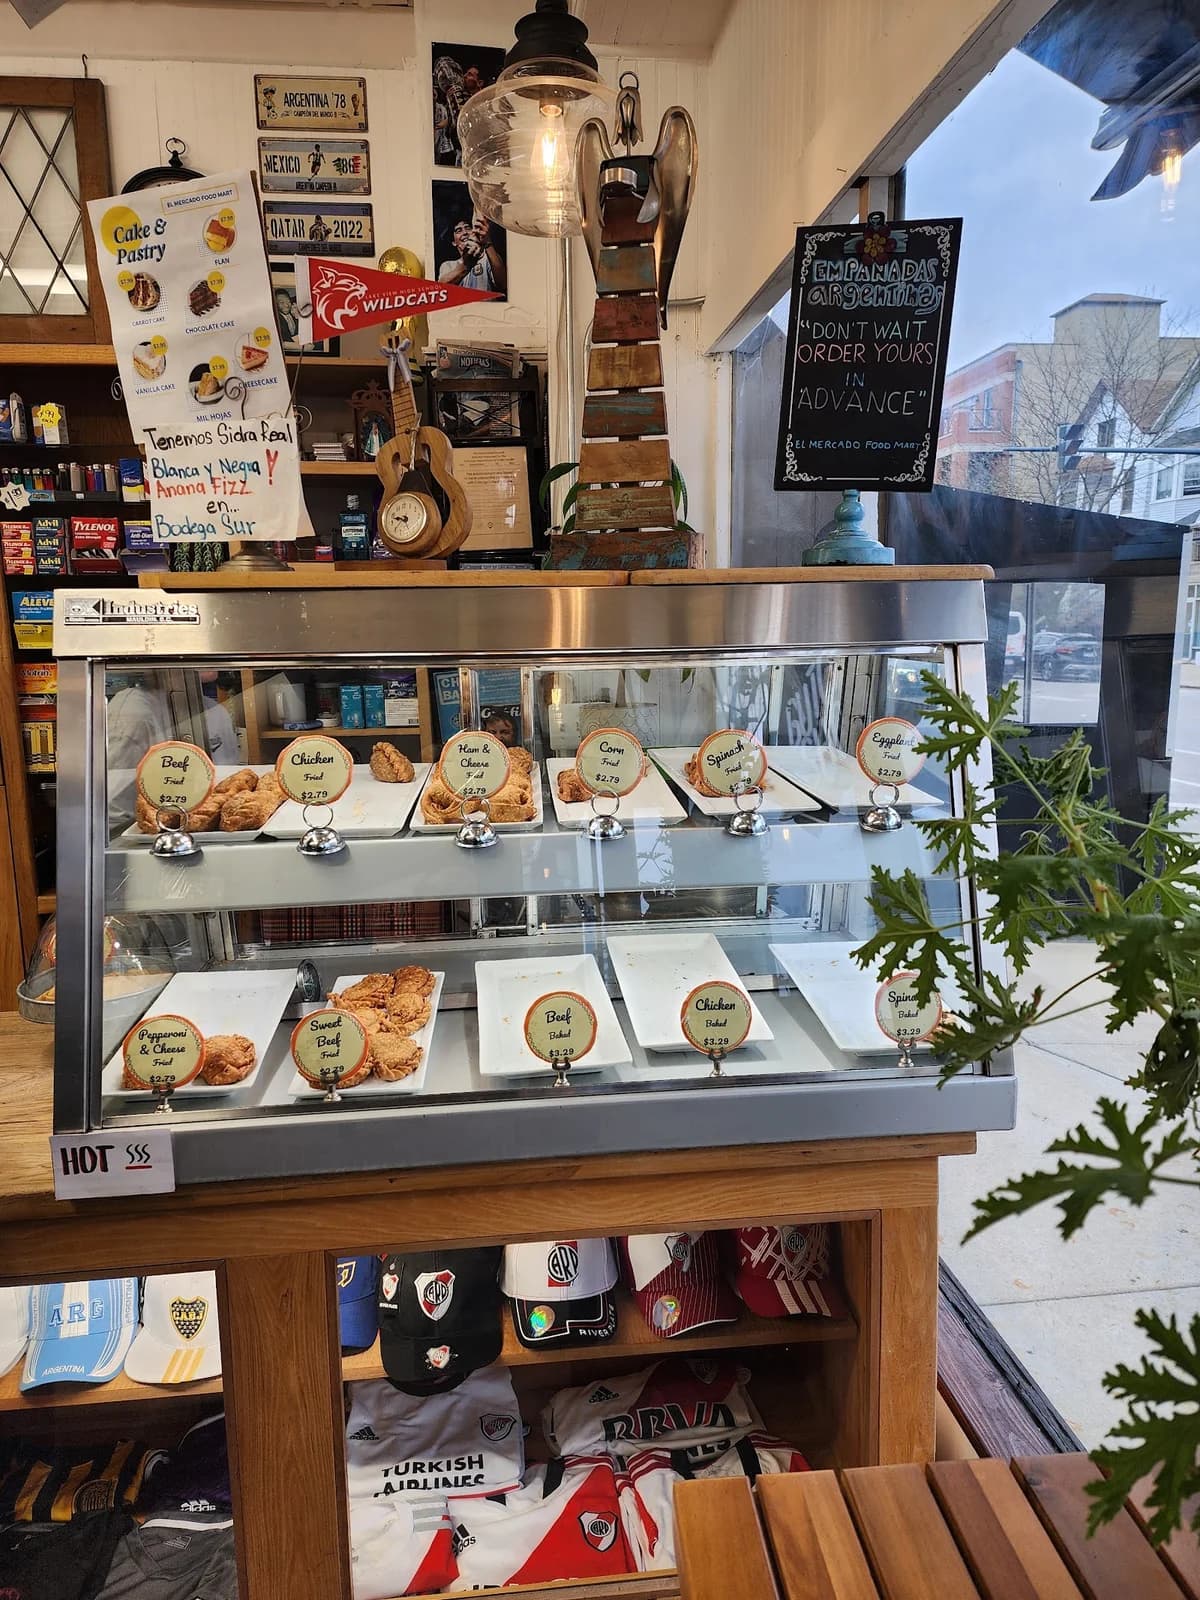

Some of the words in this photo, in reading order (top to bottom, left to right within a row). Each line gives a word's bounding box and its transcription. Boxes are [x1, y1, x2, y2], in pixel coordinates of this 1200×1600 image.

[283, 92, 329, 108] ARGENTINA
[331, 92, 347, 109] '78
[264, 155, 300, 174] MEXICO
[166, 201, 173, 209] EL
[174, 194, 200, 207] MERCADO
[201, 192, 217, 203] FOOD
[217, 189, 233, 200] MART
[113, 222, 151, 244] Cake
[154, 217, 167, 235] &
[270, 218, 305, 239] QATAR
[333, 219, 363, 238] 2022
[115, 242, 166, 266] Pastry
[214, 257, 230, 267] FLAN
[811, 257, 940, 283] EMPANADAS
[362, 289, 448, 313] WILDCATS
[131, 317, 152, 327] CARROT
[152, 315, 166, 324] CAKE
[185, 322, 218, 335] CHOCOLATE
[217, 319, 235, 329] CAKE
[873, 319, 927, 342] WAIT
[797, 343, 866, 364] ORDER
[873, 342, 934, 365] YOURS
[845, 372, 865, 388] IN
[135, 384, 160, 396] VANILLA
[160, 382, 176, 392] CAKE
[196, 413, 210, 423] MIL
[210, 410, 232, 421] HOJAS
[142, 426, 214, 452] Tenemos
[217, 422, 259, 446] Sidra
[261, 419, 294, 444] Real
[795, 439, 806, 449] EL
[808, 440, 861, 450] MERCADO
[865, 440, 891, 450] FOOD
[151, 456, 201, 480] Blanca
[219, 457, 262, 481] Negra
[155, 478, 207, 499] Anana
[211, 475, 253, 497] Fizz
[36, 519, 59, 527] Advil
[73, 520, 116, 532] TYLENOL
[154, 513, 217, 542] Bodega
[220, 512, 257, 537] Sur
[36, 538, 60, 546] Advil
[39, 557, 62, 565] Advil
[104, 600, 199, 616] Industries
[599, 740, 625, 756] Corn
[872, 732, 917, 750] Eggplant
[457, 743, 482, 755] Ham
[483, 743, 490, 755] &
[706, 739, 746, 768] Spinach
[882, 751, 901, 760] Fried
[161, 754, 190, 773] Beef
[291, 751, 334, 766] Chicken
[460, 758, 490, 769] Cheese
[600, 759, 621, 768] Fried
[465, 769, 484, 780] Fried
[724, 761, 742, 777] Fried
[877, 767, 902, 778] $2.79
[163, 776, 185, 787] Fried
[303, 771, 324, 782] Fried
[595, 774, 620, 784] $2.79
[301, 789, 328, 801] $2.79
[462, 786, 487, 796] $2.79
[159, 793, 187, 804] $2.79
[695, 997, 737, 1012] Chicken
[888, 990, 917, 1008] Spina
[545, 1007, 572, 1025] Beef
[898, 1009, 919, 1019] Baked
[310, 1015, 343, 1032] Sweet
[705, 1018, 728, 1028] Baked
[138, 1028, 188, 1043] Pepperoni
[549, 1028, 572, 1040] Baked
[896, 1027, 921, 1036] $3.29
[315, 1032, 342, 1049] Beef
[703, 1036, 729, 1047] $3.29
[139, 1044, 150, 1056] &
[152, 1042, 187, 1055] Cheese
[320, 1048, 340, 1060] Fried
[549, 1047, 574, 1058] $3.29
[152, 1057, 174, 1067] Fried
[149, 1074, 176, 1083] $2.79
[60, 1144, 115, 1176] HOT
[48, 1298, 104, 1328] ARG
[578, 1328, 609, 1337] RIVER
[41, 1365, 85, 1377] ARGENTINA
[380, 1453, 485, 1478] TURKISH
